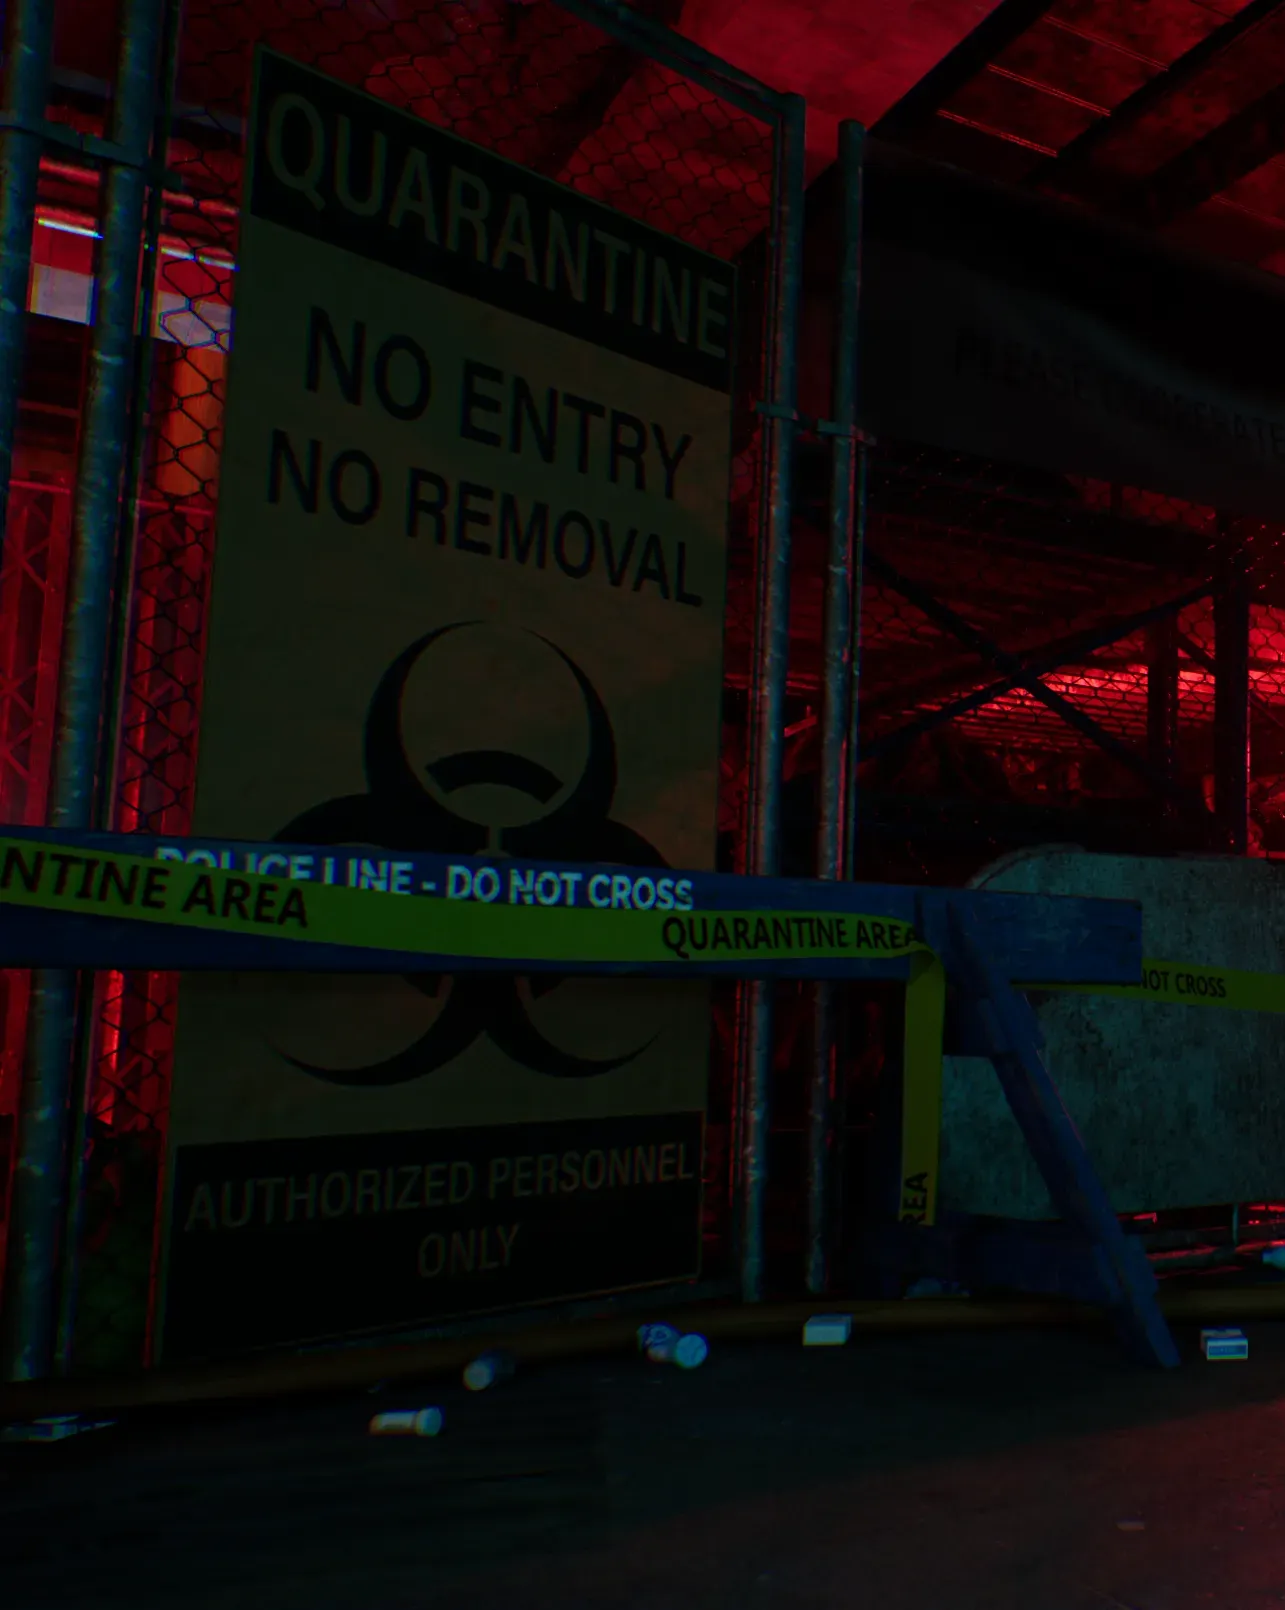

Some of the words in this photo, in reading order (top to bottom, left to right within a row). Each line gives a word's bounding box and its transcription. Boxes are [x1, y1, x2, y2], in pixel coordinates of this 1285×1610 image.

[267, 92, 727, 359] QUARANTINE
[304, 305, 432, 421] NO
[459, 358, 692, 499] ENTRY
[266, 427, 381, 526] NO
[406, 466, 704, 607] REMOVAL
[0, 846, 171, 909] NTINE
[180, 875, 309, 928] AREA
[446, 864, 500, 903] DO
[508, 868, 583, 908] NOT
[588, 873, 694, 911] CROSS
[661, 916, 848, 958] QUARANTINE
[856, 919, 917, 950] AREA
[1175, 972, 1228, 999] CROSS
[183, 1160, 475, 1233] AUTHORIZED
[487, 1140, 697, 1201] PERSONNEL
[415, 1220, 525, 1280] ONLY
